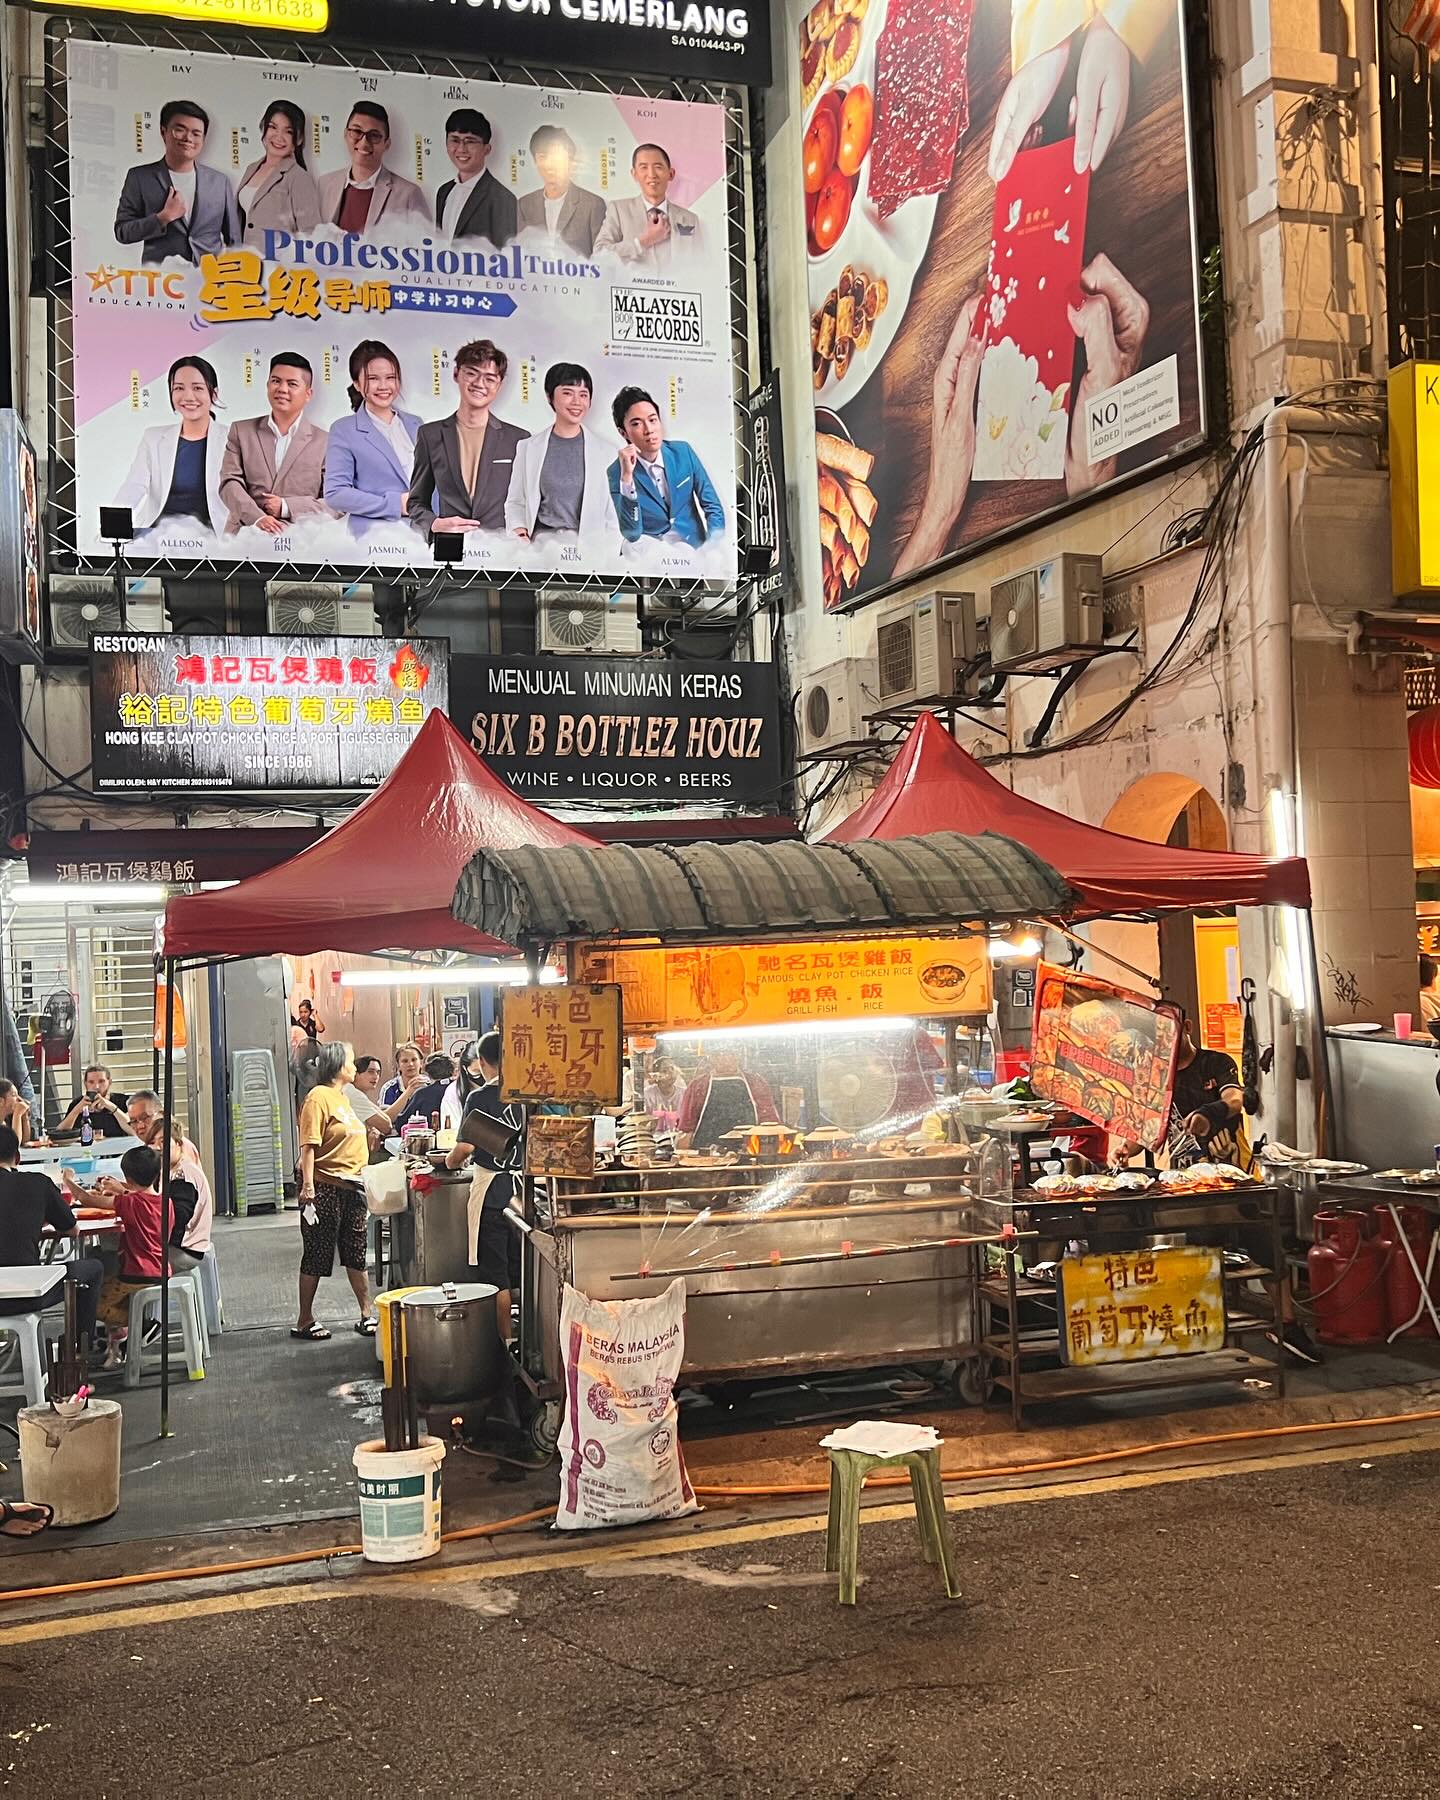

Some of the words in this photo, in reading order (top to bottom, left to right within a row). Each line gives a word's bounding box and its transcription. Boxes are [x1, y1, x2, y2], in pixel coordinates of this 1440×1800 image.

[561, 0, 749, 38] CEMERLANG
[671, 35, 687, 47] SA
[689, 38, 745, 54] 0104443-P)
[172, 65, 192, 74] BAY
[262, 72, 299, 82] STEPHY
[443, 92, 469, 101] HERN
[636, 109, 657, 119] KOH
[263, 228, 523, 280] Professional
[524, 253, 600, 279] Tutors
[199, 251, 392, 323] 星级导师
[401, 274, 474, 289] QUALITY
[485, 280, 582, 296] EDUCATION
[632, 278, 665, 286] AWARDED
[89, 297, 185, 310] EDUCATION
[394, 290, 493, 310] 中学补习中心
[614, 294, 699, 317] MALAYSIA
[615, 311, 634, 324] BOOK
[618, 324, 631, 339] of
[635, 316, 700, 342] RECORDS
[1091, 402, 1118, 432] NO
[1094, 429, 1120, 448] ADDED
[160, 538, 204, 549] ALLISON
[273, 537, 291, 545] ZHI
[273, 544, 291, 552] BIN
[367, 545, 407, 556] JASMINE
[560, 553, 582, 562] MUN
[660, 557, 691, 567] ALWIN
[94, 636, 165, 653] RESTORAN
[488, 668, 576, 696] MENJUAL
[584, 671, 672, 699] MINUMAN
[680, 674, 743, 700] KERAS
[105, 732, 139, 745] HONG
[141, 732, 165, 745] KEE
[166, 732, 218, 745] CLAYPOT
[220, 732, 269, 745] CHICKEN
[272, 732, 297, 744] RICE
[300, 732, 308, 744] &
[311, 732, 383, 744] PORTUGUESE
[469, 712, 520, 756] SIX
[525, 714, 547, 757] B
[554, 714, 680, 759] BOTTLEZ
[686, 717, 765, 759] HOUZ
[244, 755, 280, 769] SINCE
[282, 755, 313, 769] 1986
[161, 778, 190, 786] KITCHEN
[507, 771, 559, 787] WINE
[581, 773, 658, 788] LIQUOR
[678, 774, 732, 788] BEERS
[756, 974, 794, 984] FAMOUS
[799, 972, 822, 982] CLAY
[827, 970, 845, 980] POT
[849, 968, 890, 978] CHICKEN
[894, 966, 913, 976] RICE
[531, 990, 592, 1024] 特色
[786, 1005, 813, 1015] GRILL
[817, 1004, 838, 1013] FISH
[864, 1001, 884, 1010] RICE
[511, 1024, 605, 1065] 葡萄牙
[1104, 1252, 1159, 1291] 特色
[586, 1333, 624, 1354] BERAS
[627, 1323, 680, 1354] MALAYSIA
[590, 1348, 615, 1364] BERAS
[616, 1354, 643, 1365] REBUS
